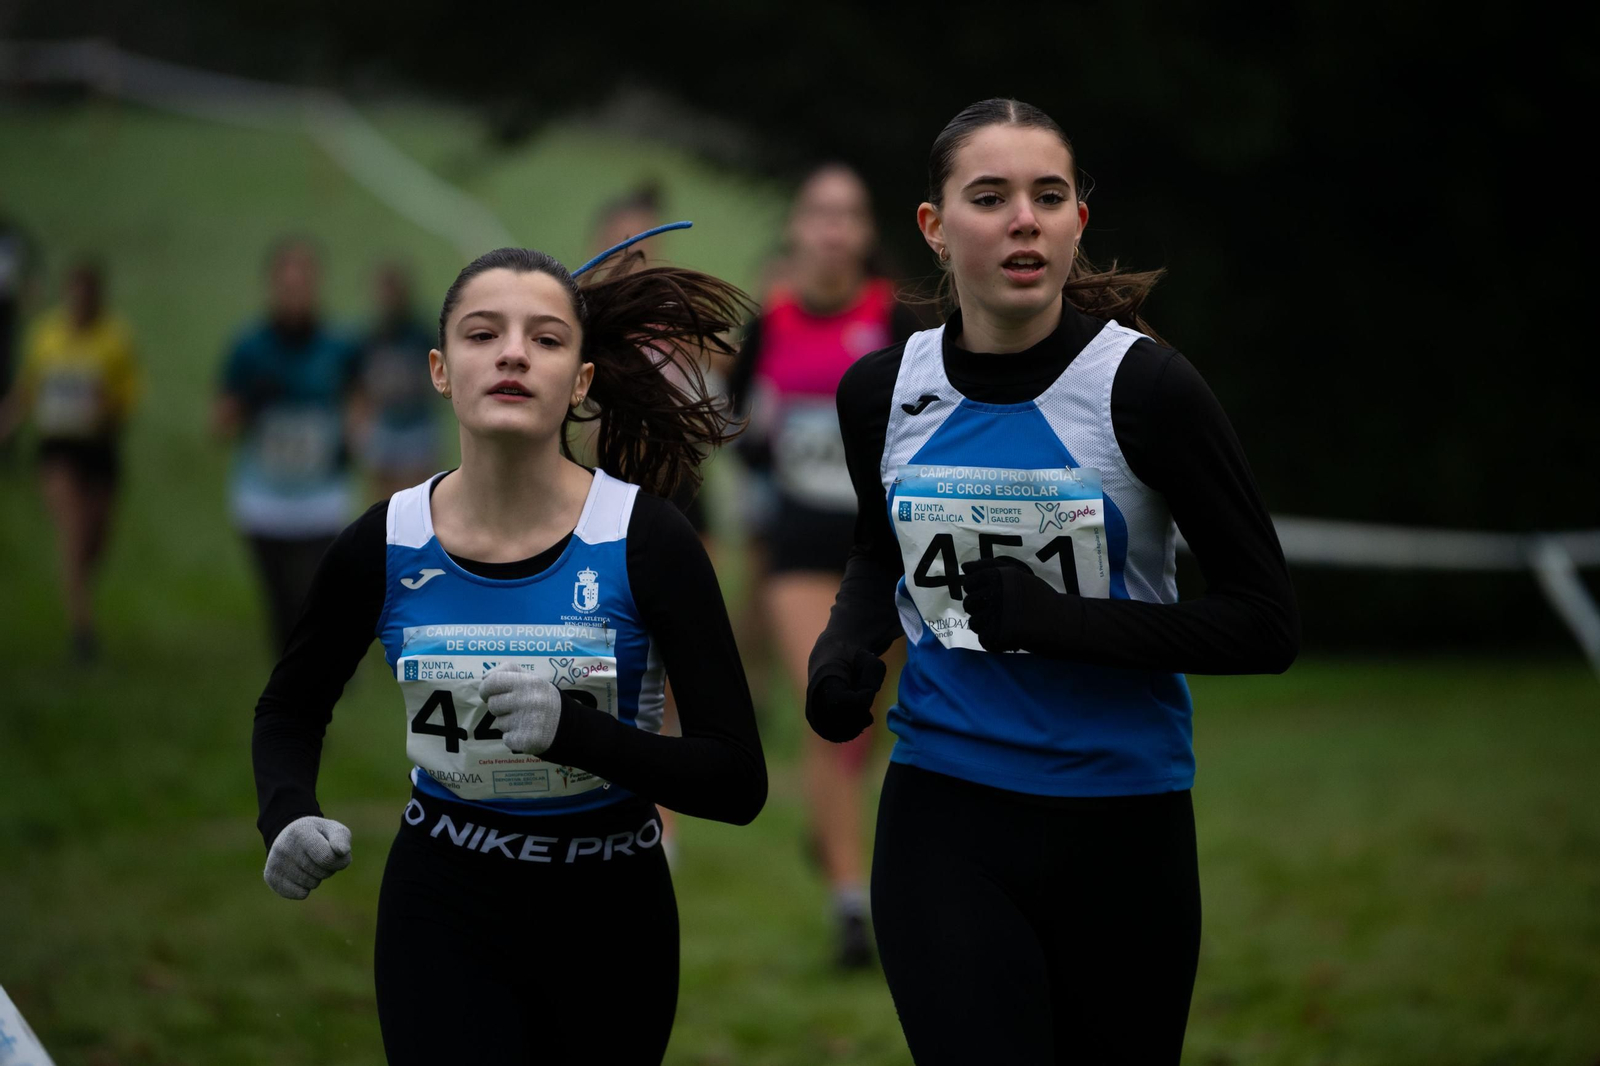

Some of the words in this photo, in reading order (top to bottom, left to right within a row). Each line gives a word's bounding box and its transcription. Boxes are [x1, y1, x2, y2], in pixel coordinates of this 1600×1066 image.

[919, 466, 997, 481] CAMPIONATO
[1001, 469, 1081, 482] PROVINCIAL
[937, 482, 953, 494] DE
[957, 483, 991, 495] CROS
[995, 485, 1058, 497] ESCOLAR
[914, 503, 944, 513] XUNTA
[990, 507, 1022, 515] DEPORTE
[914, 513, 926, 521] DE
[928, 513, 964, 523] GALICIA
[991, 516, 1020, 524] GALEGO
[583, 615, 611, 623] ATLÉTICA
[426, 625, 513, 638] CAMPIONATO
[516, 626, 597, 640] PROVINCIAL
[446, 640, 463, 651] DE
[468, 640, 506, 651] CROS
[509, 640, 574, 652] ESCOLAR
[421, 661, 454, 670] XUNTA
[421, 671, 434, 680] DE
[436, 671, 474, 680] GALICIA
[430, 813, 560, 863] NIKE
[564, 818, 662, 864] PRO
